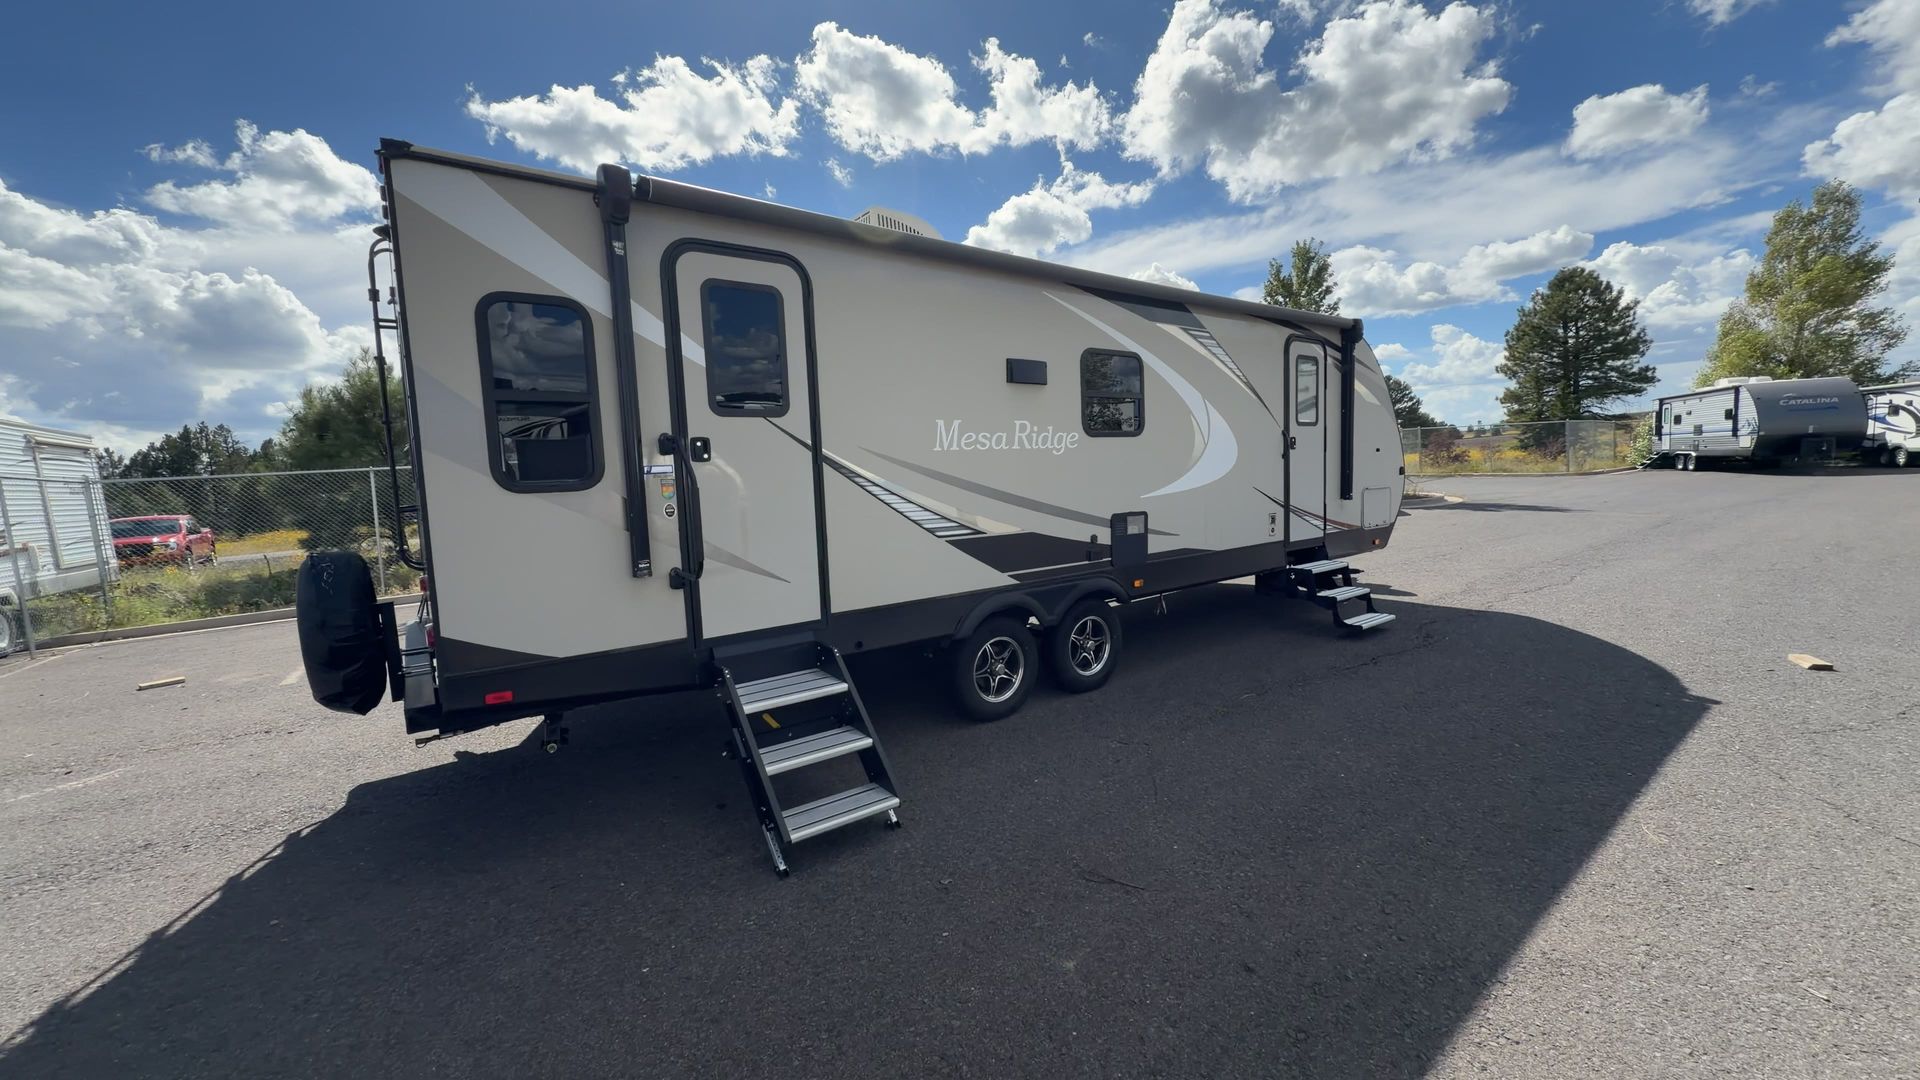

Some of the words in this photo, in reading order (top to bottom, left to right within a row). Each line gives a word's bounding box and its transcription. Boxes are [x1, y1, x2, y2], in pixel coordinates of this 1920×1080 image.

[1779, 397, 1839, 406] CATALINA
[933, 419, 1009, 451] Mesa
[1012, 420, 1079, 455] Ridge
